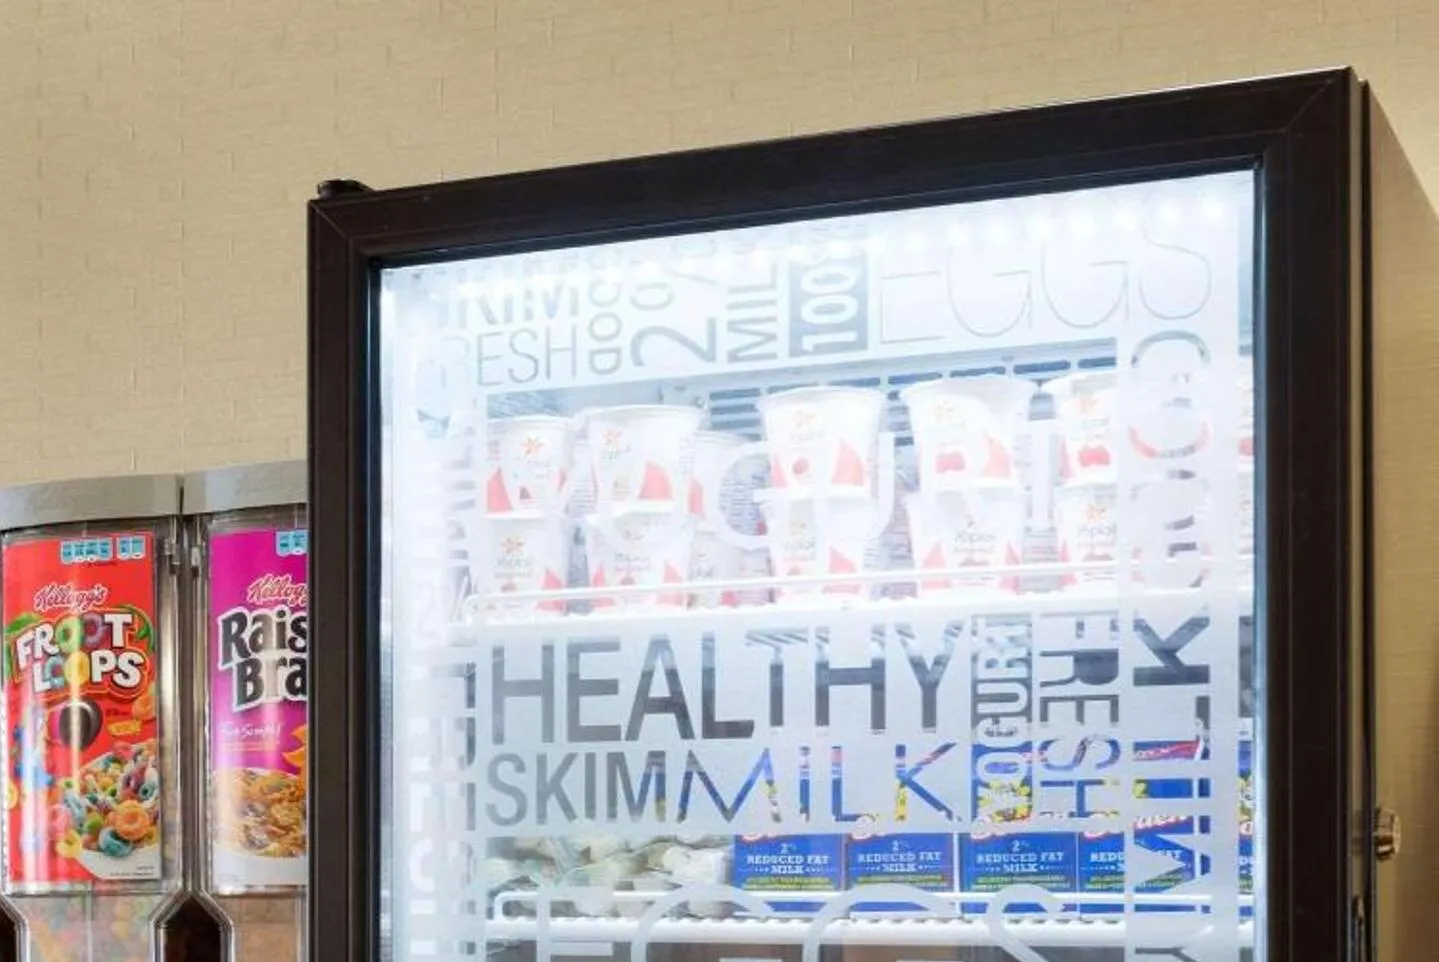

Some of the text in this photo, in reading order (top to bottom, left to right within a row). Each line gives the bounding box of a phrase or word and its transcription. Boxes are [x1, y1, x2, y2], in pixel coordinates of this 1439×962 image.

[726, 250, 779, 363] MIL
[35, 574, 109, 614] Kellogg's
[17, 612, 133, 669] FROOT
[220, 608, 307, 666] Rais
[33, 648, 144, 693] LOOPS
[235, 655, 307, 706] Bra
[491, 620, 962, 745] HEALTHY
[746, 854, 831, 865] REDUCED FAT
[770, 865, 804, 875] MILK
[857, 851, 941, 864] REDUCED FAT
[882, 863, 917, 873] MILK
[976, 851, 1065, 864] REDUCED FAT
[1003, 862, 1039, 873] MILK
[1090, 851, 1125, 863] REDU
